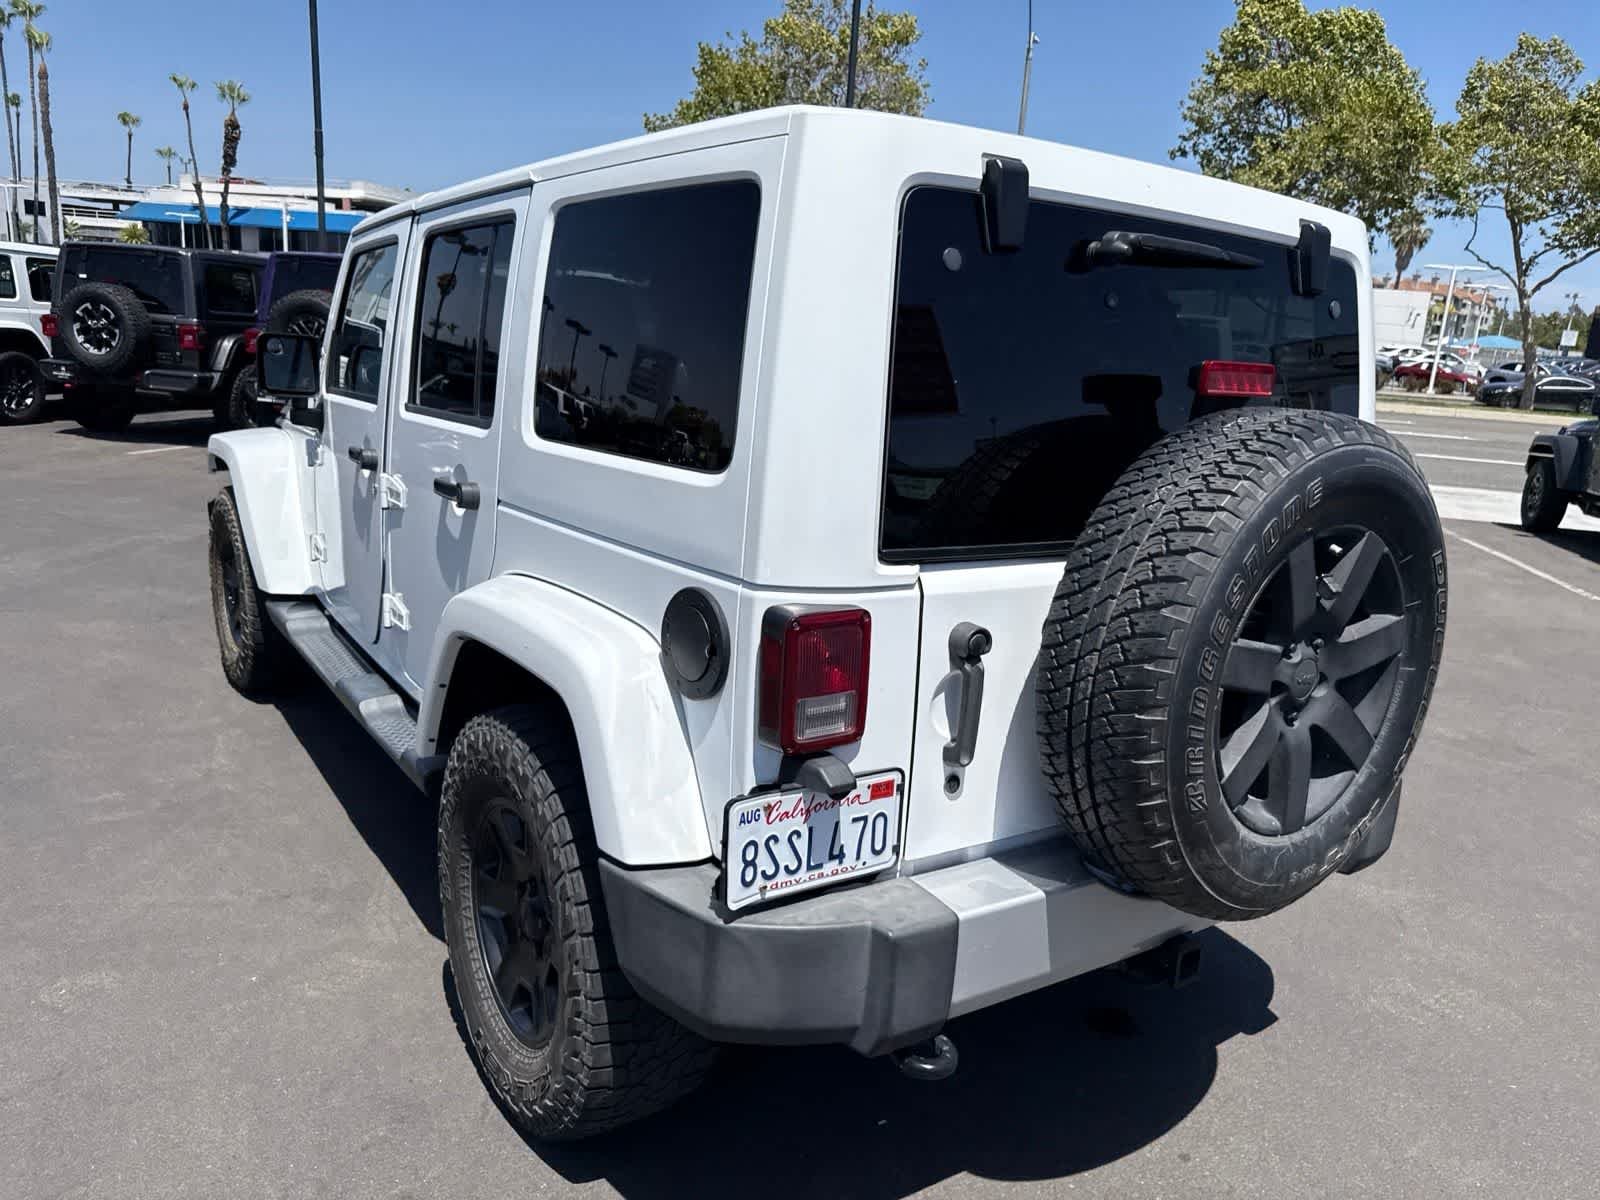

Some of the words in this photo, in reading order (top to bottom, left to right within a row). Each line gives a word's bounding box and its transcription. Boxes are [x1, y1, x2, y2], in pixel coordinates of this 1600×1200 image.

[1184, 476, 1323, 813] BRIDGESTONE
[739, 808, 761, 826] AUG
[765, 793, 871, 825] California
[740, 811, 889, 889] 8SSL470
[769, 864, 858, 891] dmv.ca.gov
